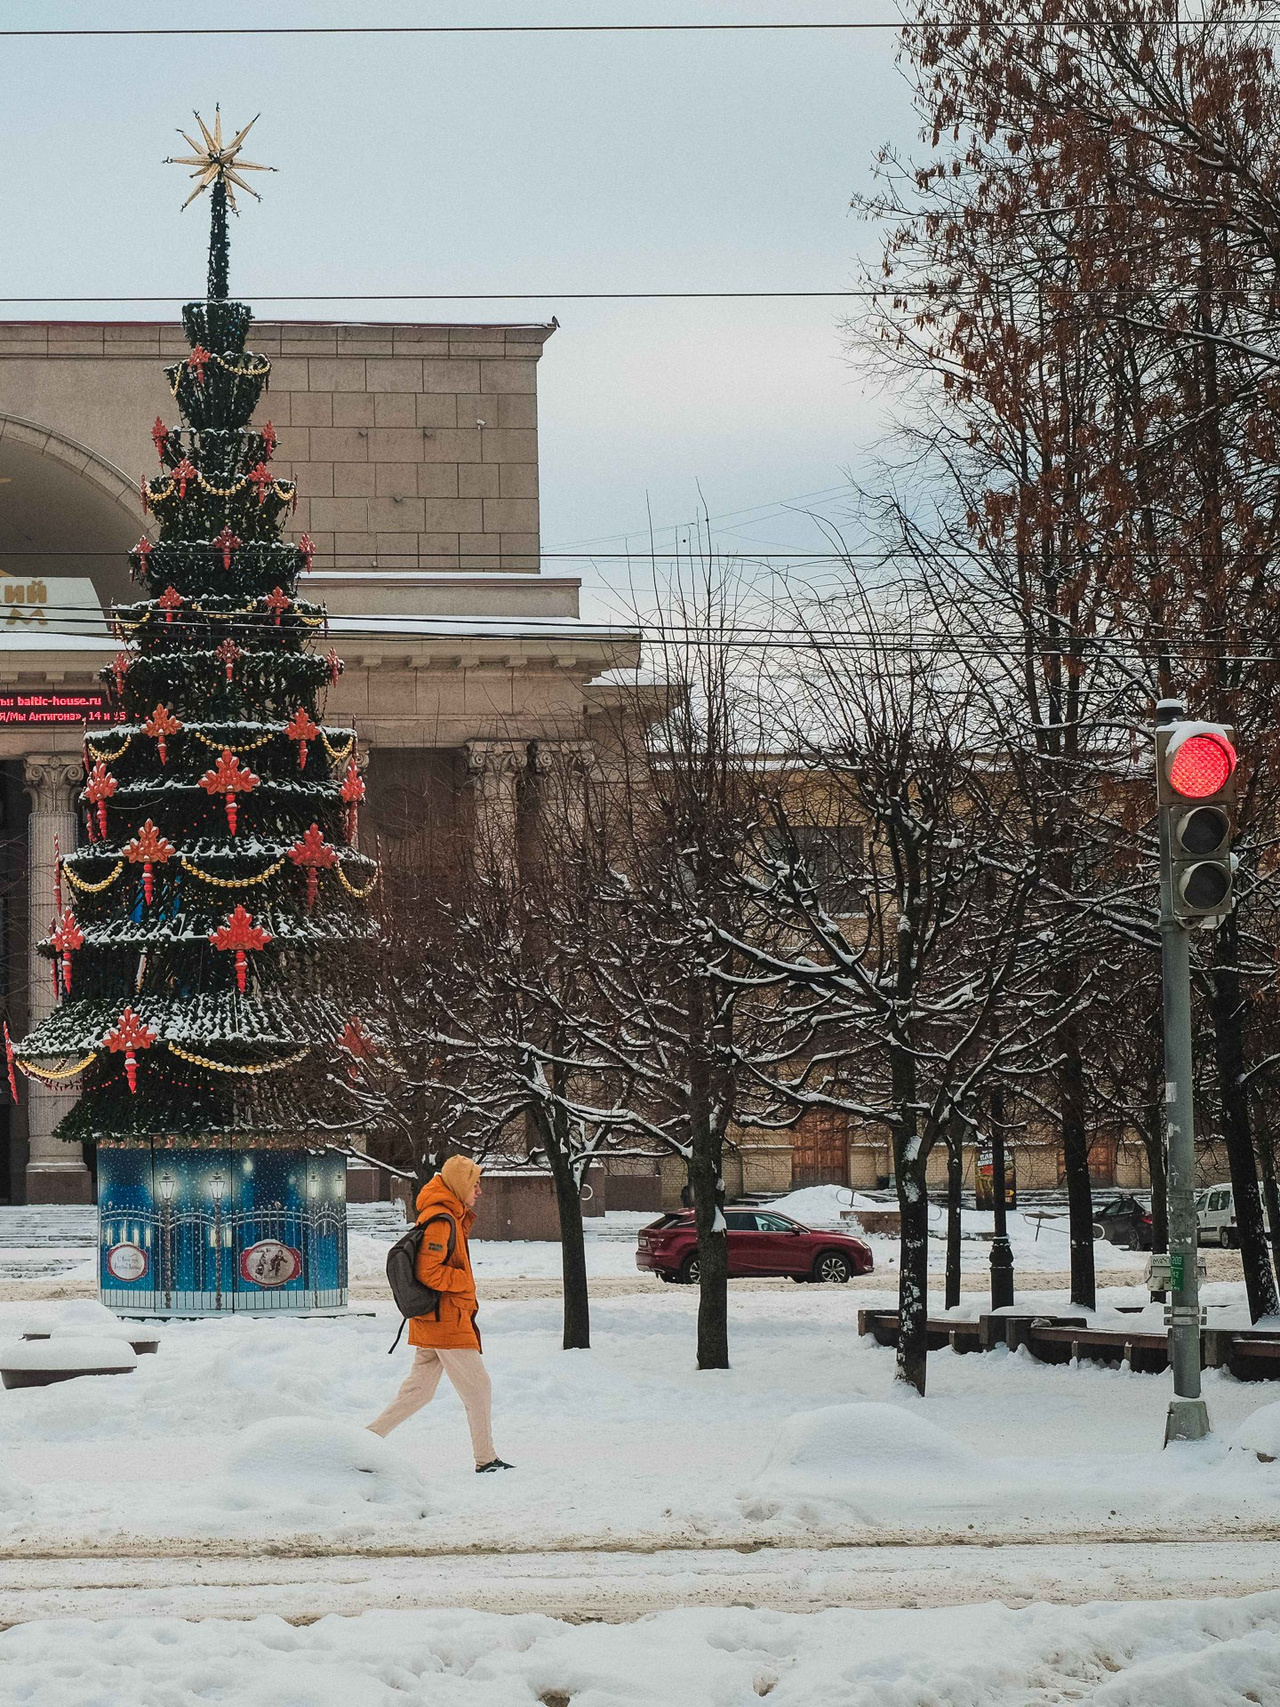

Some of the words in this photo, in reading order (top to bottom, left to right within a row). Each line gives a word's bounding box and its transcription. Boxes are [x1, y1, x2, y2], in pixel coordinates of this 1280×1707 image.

[17, 696, 102, 706] baltic-house.ru
[89, 711, 102, 721] 14
[104, 712, 111, 721] и
